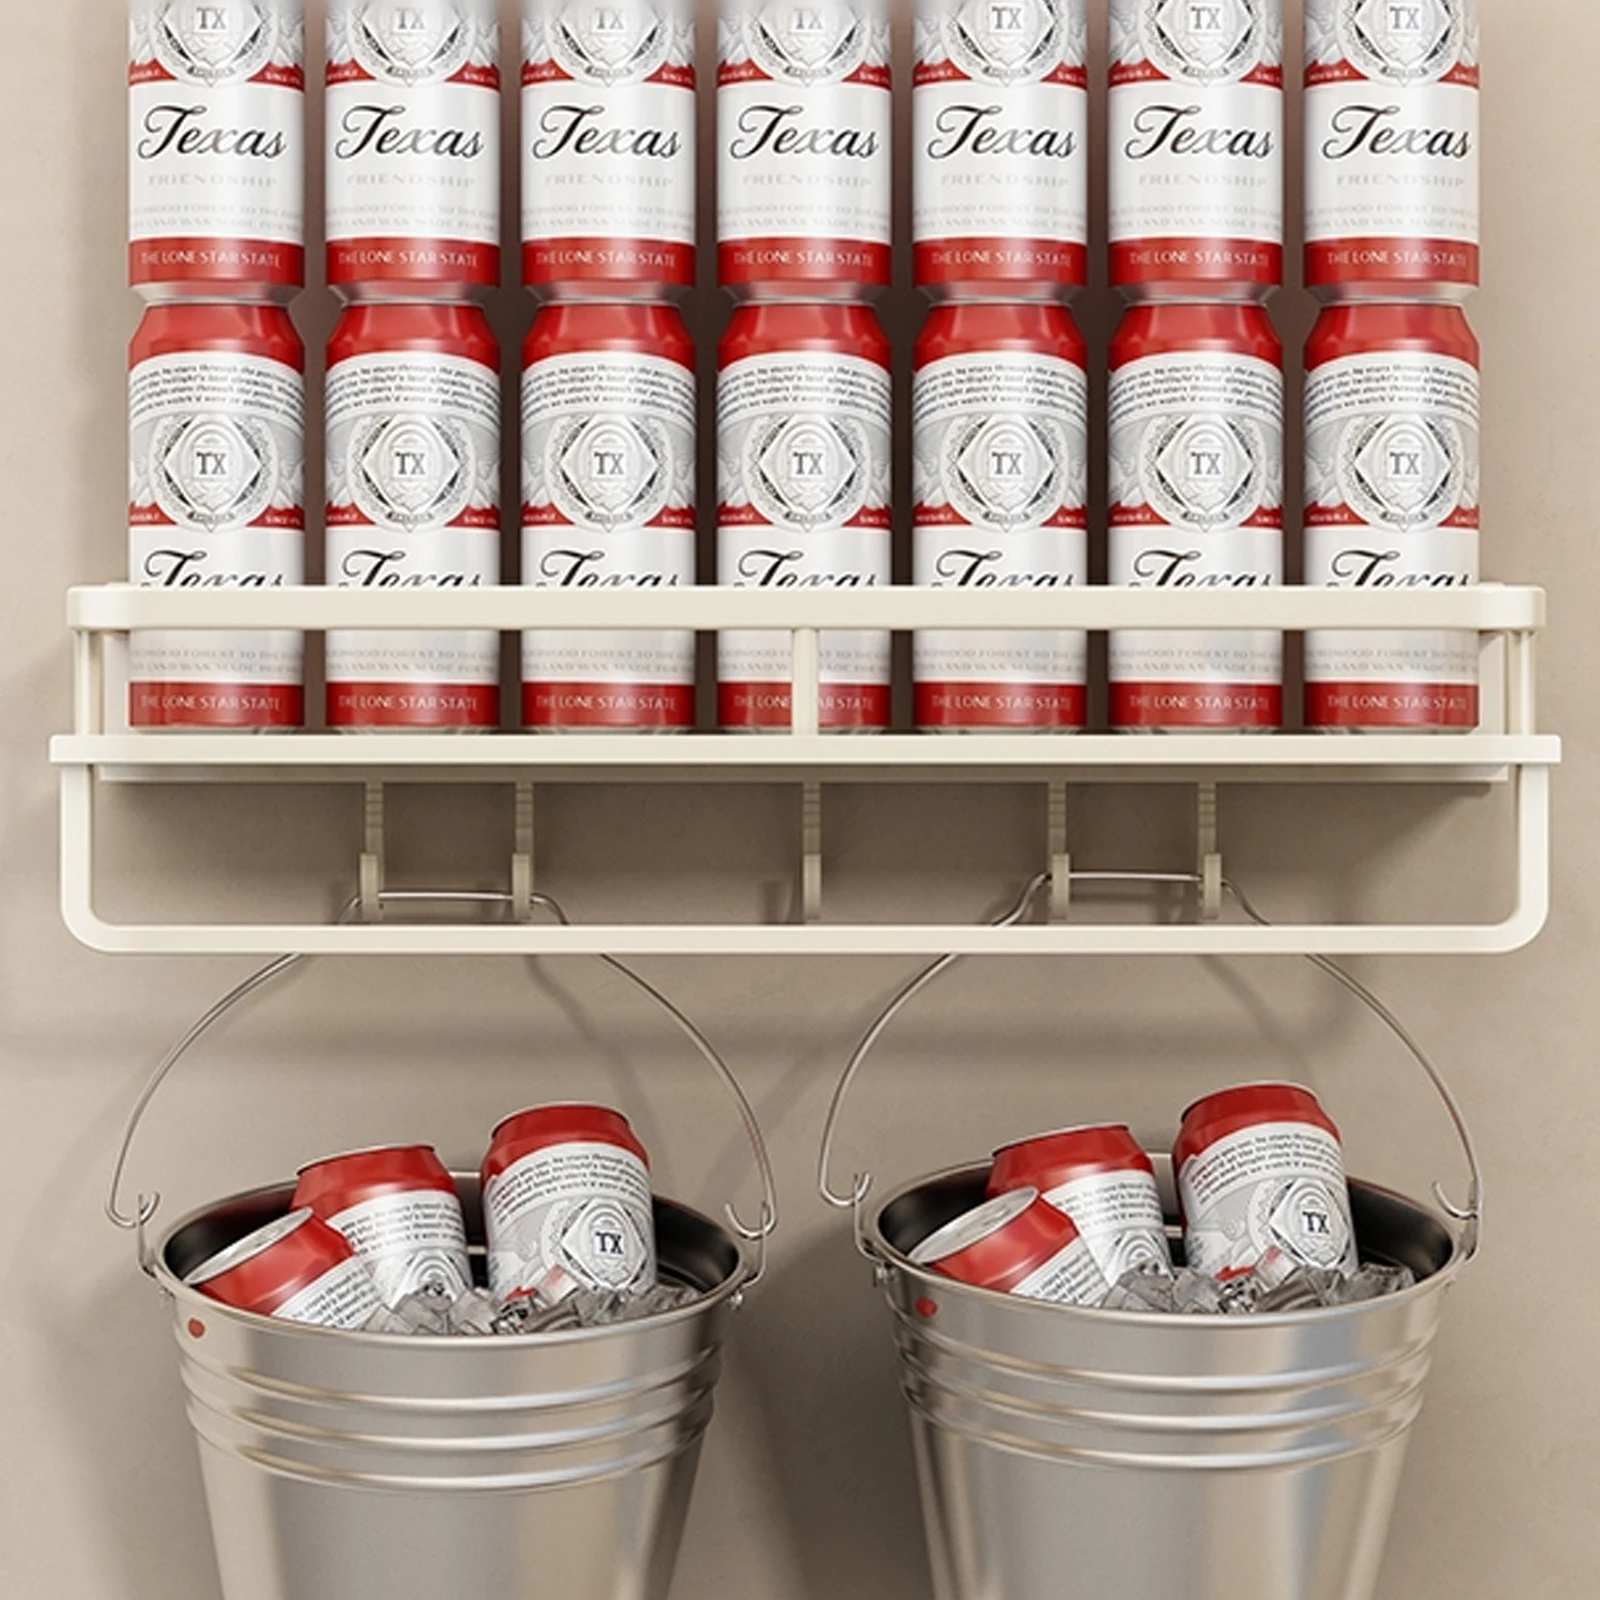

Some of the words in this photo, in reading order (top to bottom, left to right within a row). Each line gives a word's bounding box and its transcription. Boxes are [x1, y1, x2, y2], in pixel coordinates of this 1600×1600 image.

[196, 6, 227, 30] TX
[395, 6, 426, 30] TX
[594, 6, 625, 30] TX
[793, 6, 824, 30] TX
[992, 6, 1023, 30] TX
[1190, 6, 1221, 30] TX
[1389, 6, 1420, 30] TX
[136, 104, 287, 159] Texas
[334, 104, 485, 159] Texas
[531, 104, 682, 159] Texas
[729, 104, 880, 159] Texas
[926, 104, 1077, 159] Texas
[1124, 104, 1275, 159] Texas
[1322, 104, 1473, 159] Texas
[147, 173, 278, 188] FRIENDSHIP
[346, 173, 477, 188] FRIENDSHIP
[544, 173, 675, 188] FRIENDSHIP
[743, 173, 874, 188] FRIENDSHIP
[941, 173, 1072, 188] FRIENDSHIP
[1140, 173, 1271, 188] FRIENDSHIP
[1338, 173, 1469, 188] FRIENDSHIP
[161, 249, 197, 265] LONE
[198, 249, 239, 265] STAR
[239, 250, 281, 268] STATE
[359, 249, 396, 265] LONE
[397, 249, 438, 265] STAR
[438, 250, 478, 268] STATE
[557, 249, 595, 265] LONE
[596, 249, 638, 265] STAR
[637, 250, 676, 268] STATE
[756, 249, 794, 265] LONE
[795, 249, 836, 265] STAR
[835, 250, 875, 268] STATE
[954, 249, 992, 265] LONE
[994, 249, 1035, 265] STAR
[1034, 250, 1073, 268] STATE
[1153, 249, 1191, 265] LONE
[1192, 249, 1234, 265] STAR
[1233, 250, 1270, 268] STATE
[1350, 249, 1390, 265] LONE
[1391, 249, 1432, 265] STAR
[1431, 250, 1468, 268] STATE
[196, 451, 227, 475] TX
[395, 451, 426, 475] TX
[594, 451, 625, 475] TX
[793, 451, 824, 475] TX
[992, 451, 1023, 475] TX
[1190, 451, 1221, 475] TX
[1389, 451, 1420, 475] TX
[161, 694, 197, 710] LONE
[198, 694, 239, 710] STAR
[239, 695, 281, 713] STATE
[359, 694, 396, 710] LONE
[397, 694, 438, 710] STAR
[438, 695, 478, 713] STATE
[557, 694, 595, 710] LONE
[596, 694, 638, 710] STAR
[637, 695, 676, 713] STATE
[756, 694, 791, 710] LONE
[835, 695, 875, 713] STATE
[954, 694, 992, 710] LONE
[994, 694, 1035, 710] STAR
[1034, 695, 1073, 713] STATE
[1153, 694, 1191, 710] LONE
[1192, 694, 1234, 710] STAR
[1233, 695, 1270, 713] STATE
[1350, 694, 1390, 710] LONE
[1391, 694, 1432, 710] STAR
[1431, 695, 1468, 713] STATE
[1302, 1210, 1330, 1234] TX
[595, 1231, 624, 1255] TX
